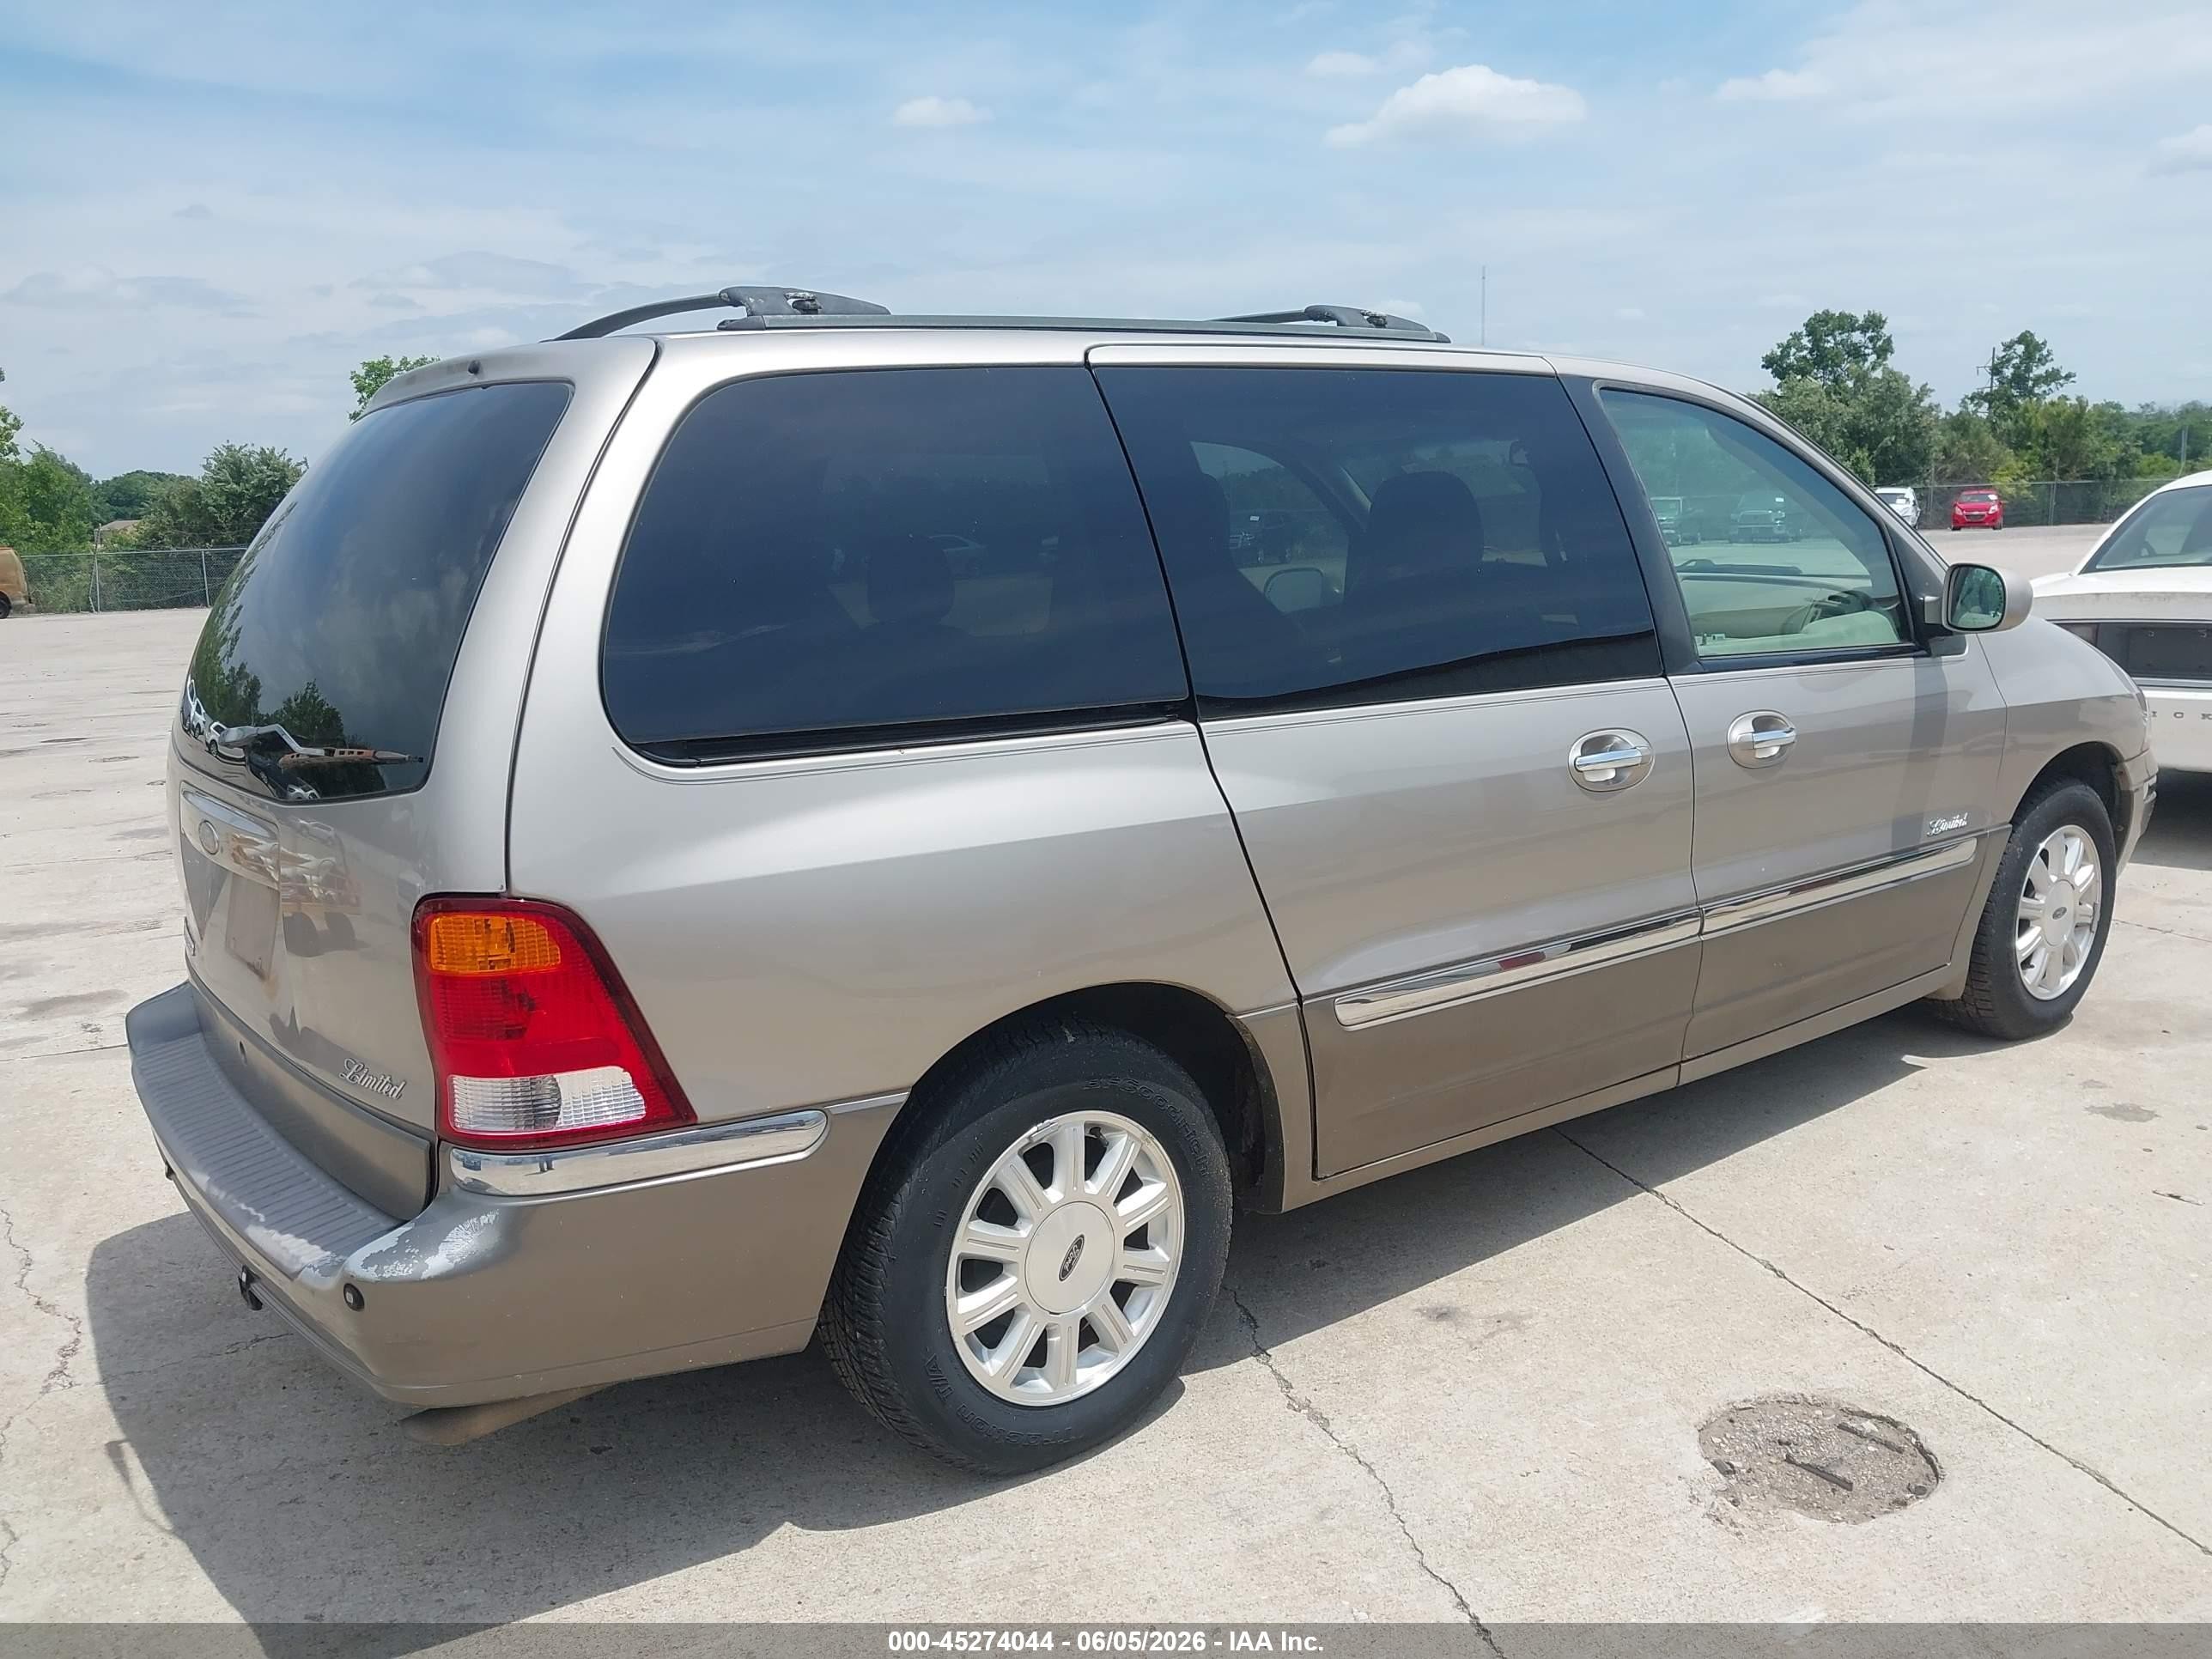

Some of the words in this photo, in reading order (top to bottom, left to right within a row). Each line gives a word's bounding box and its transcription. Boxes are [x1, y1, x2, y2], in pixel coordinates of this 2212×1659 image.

[1926, 811, 1968, 836] Limited
[338, 1058, 406, 1100] Limited
[923, 1352, 956, 1402] T/A
